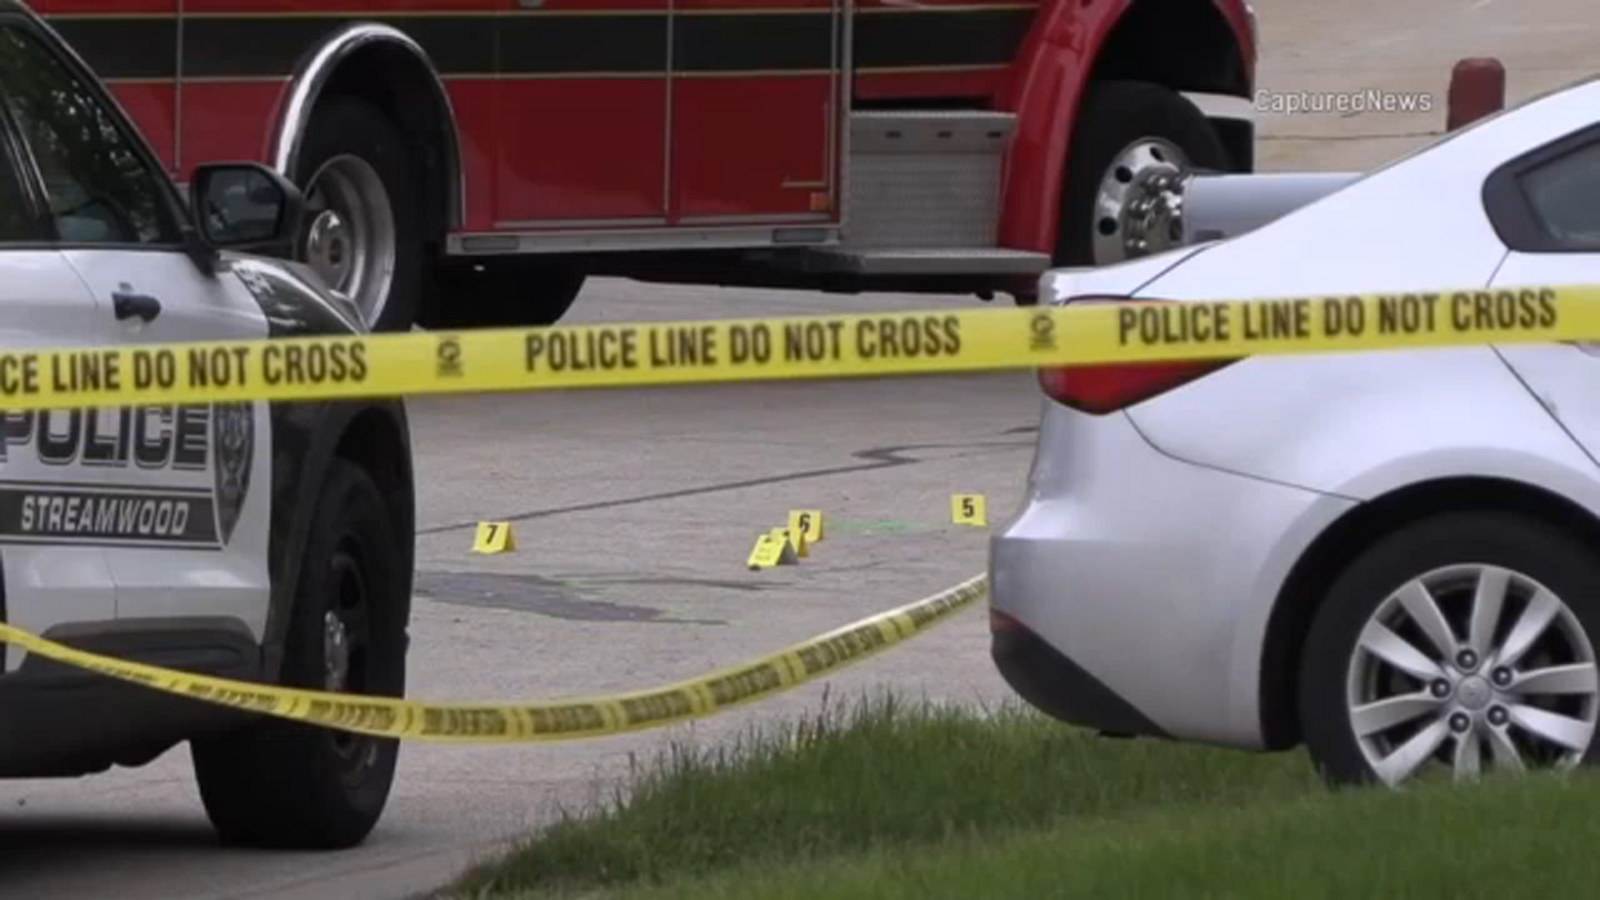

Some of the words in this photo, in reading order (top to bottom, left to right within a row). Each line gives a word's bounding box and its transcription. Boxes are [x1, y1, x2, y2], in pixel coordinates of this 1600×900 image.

[1119, 303, 1229, 346] POLICE
[1243, 299, 1310, 339] LINE
[1324, 297, 1365, 337] DO
[1379, 293, 1439, 334] NOT
[1451, 289, 1557, 330] CROSS
[526, 331, 636, 372] POLICE
[649, 326, 717, 368] LINE
[729, 324, 772, 364] DO
[784, 321, 845, 361] NOT
[856, 316, 961, 359] CROSS
[52, 352, 120, 393] LINE
[134, 350, 175, 388] DO
[189, 347, 249, 387] NOT
[262, 342, 367, 384] CROSS
[20, 496, 189, 536] STREAMWOOD
[799, 513, 811, 534] 6
[962, 498, 975, 518] 5
[486, 524, 499, 545] 7
